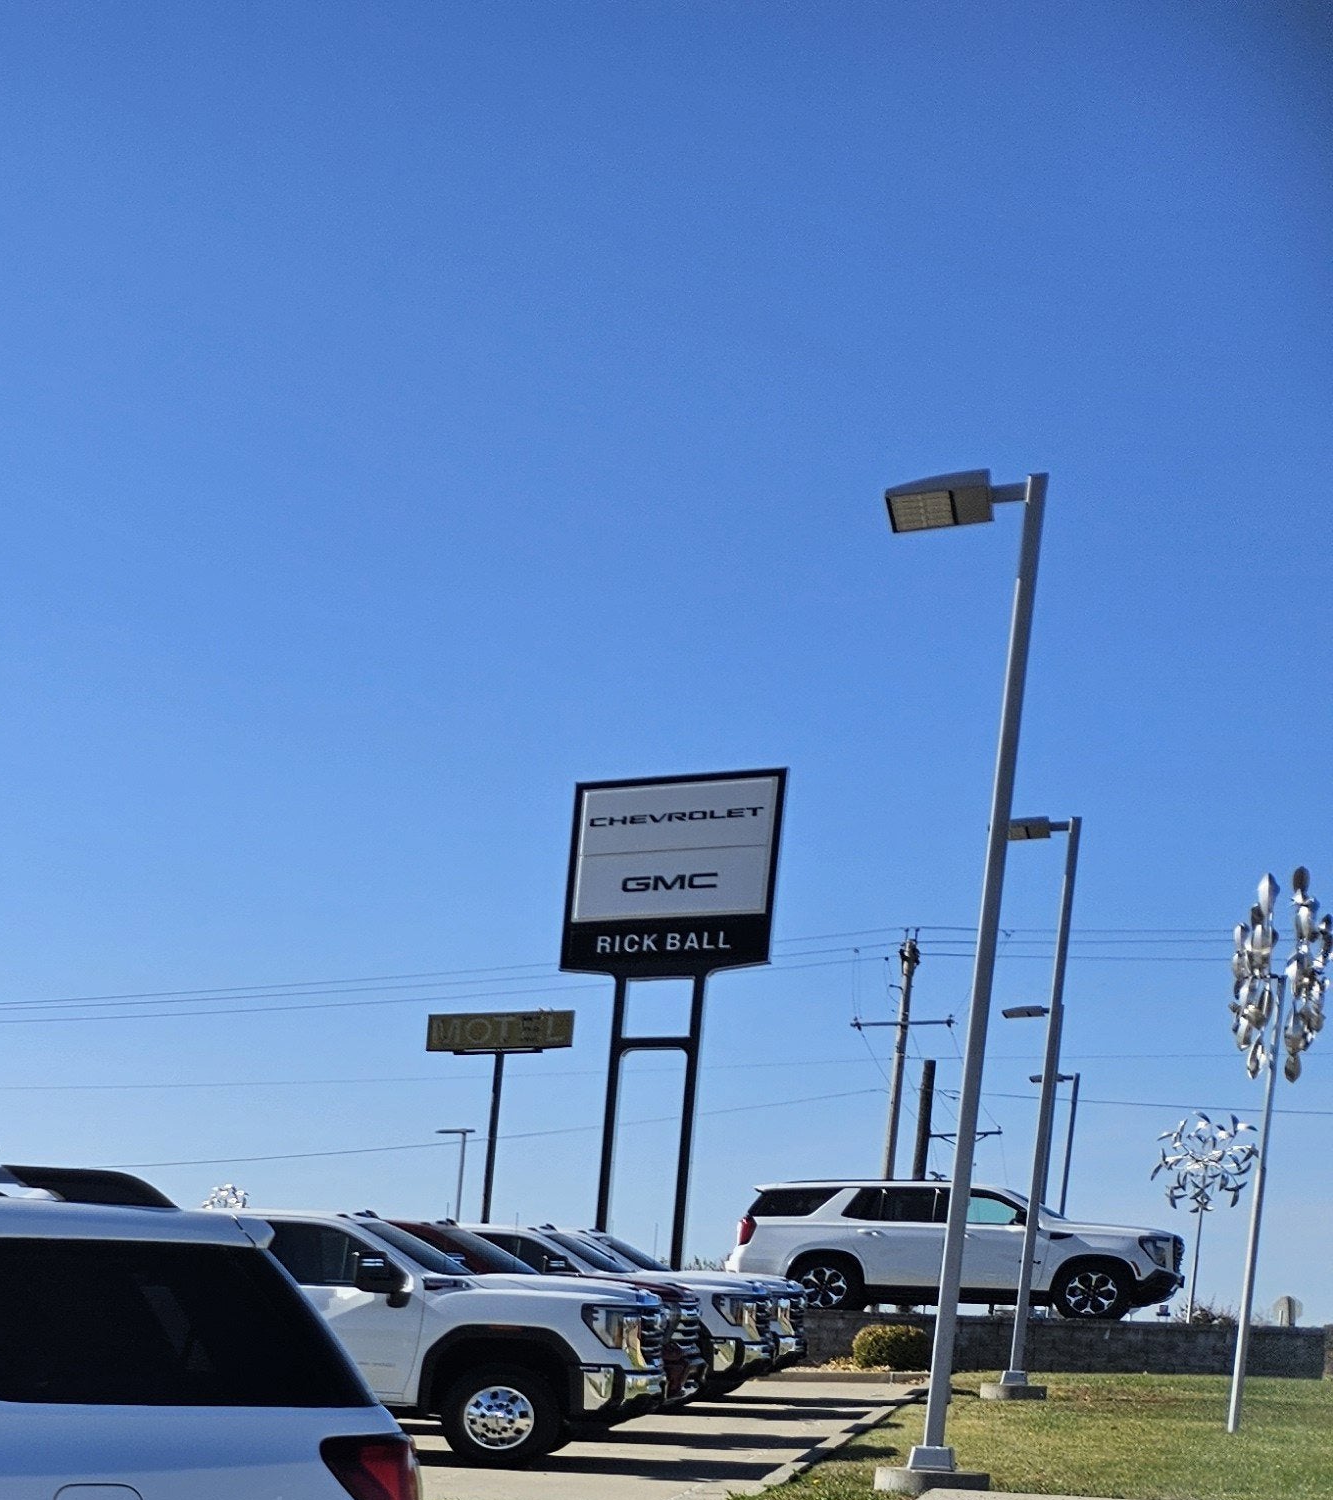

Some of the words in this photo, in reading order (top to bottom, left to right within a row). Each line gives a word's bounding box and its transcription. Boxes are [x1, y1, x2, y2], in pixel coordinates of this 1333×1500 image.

[589, 807, 764, 827] CHEVROLET
[621, 872, 719, 893] GMC
[596, 934, 658, 954] RICK
[666, 931, 732, 950] BALL
